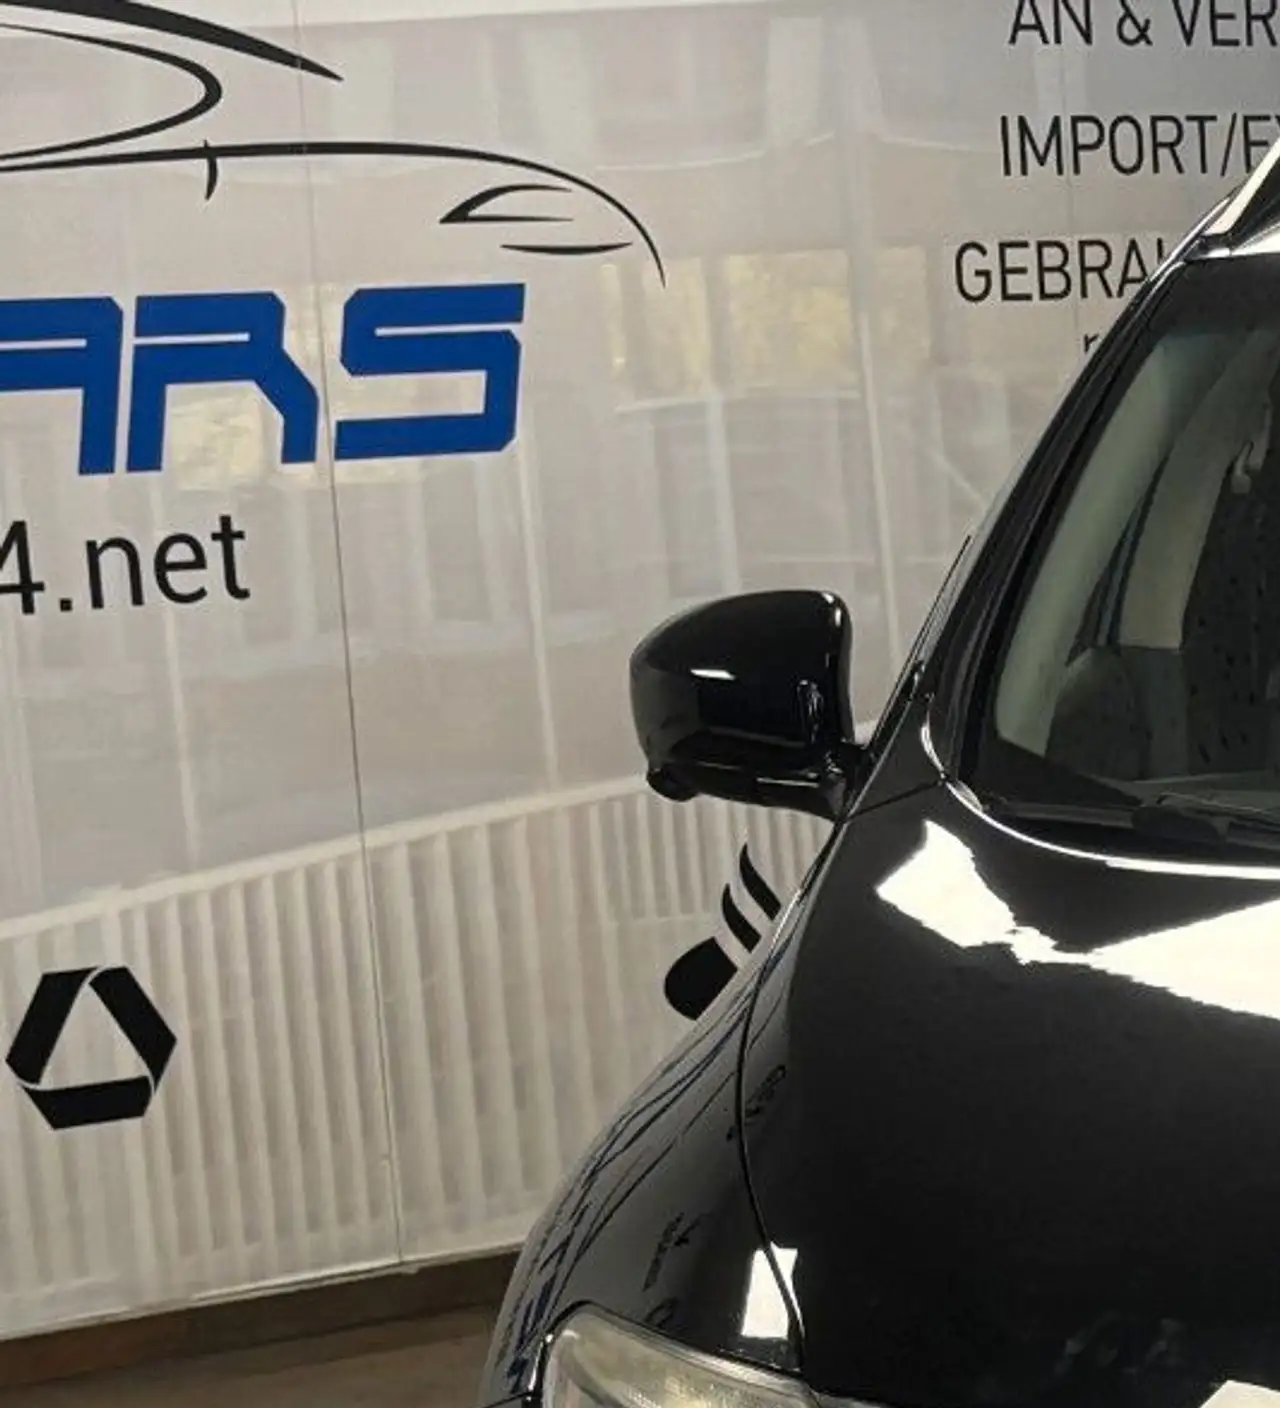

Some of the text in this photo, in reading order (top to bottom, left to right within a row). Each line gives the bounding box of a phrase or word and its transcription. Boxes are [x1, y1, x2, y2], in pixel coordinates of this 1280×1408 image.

[1008, 0, 1093, 45] AN
[1115, 0, 1153, 46] &
[955, 237, 1164, 302] GEBRA
